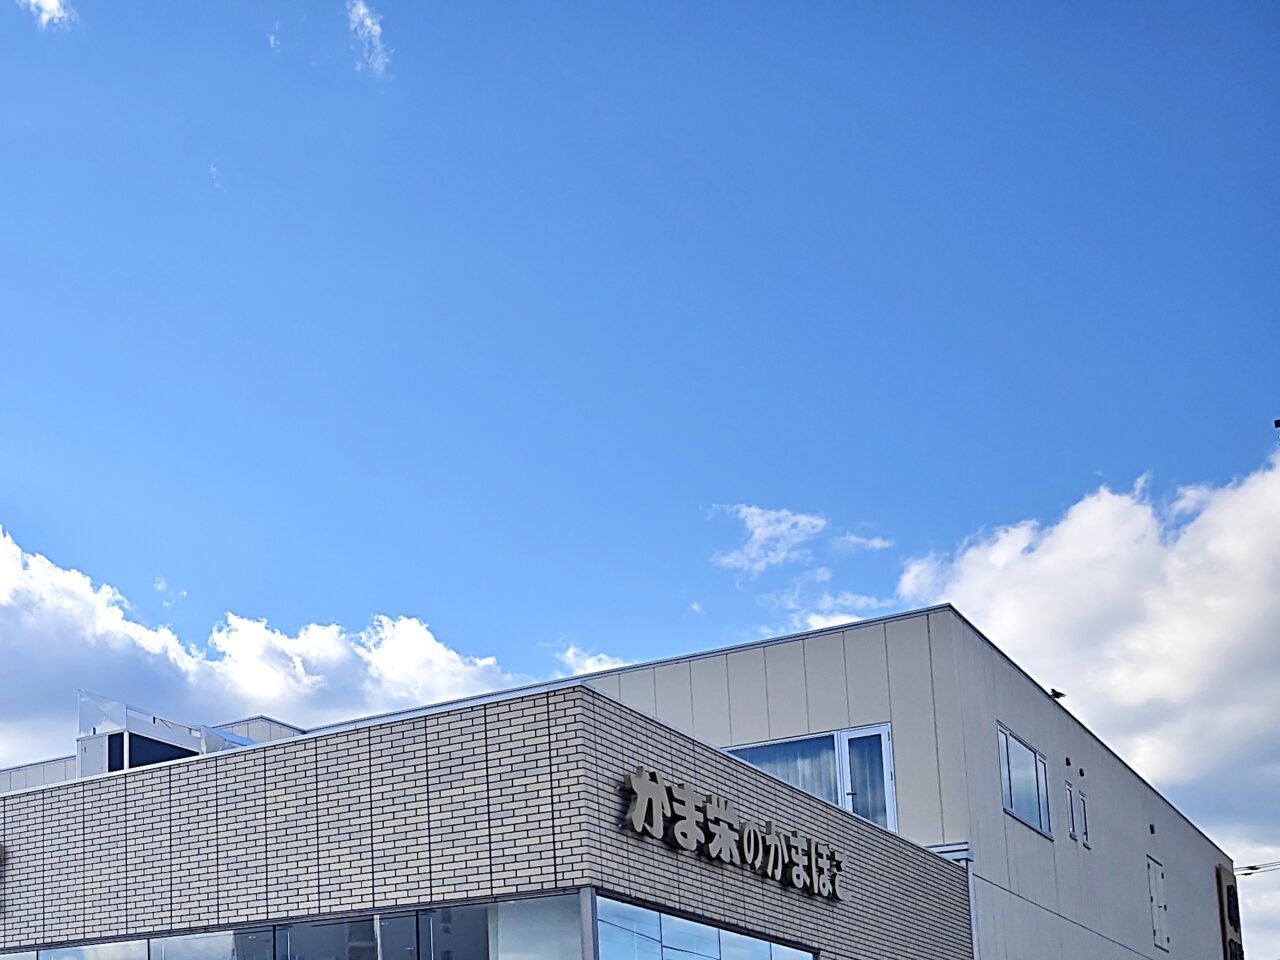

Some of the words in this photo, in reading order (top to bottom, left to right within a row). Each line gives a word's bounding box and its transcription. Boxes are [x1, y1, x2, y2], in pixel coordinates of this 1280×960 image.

[625, 766, 853, 902] かま栄のかまぼこ
